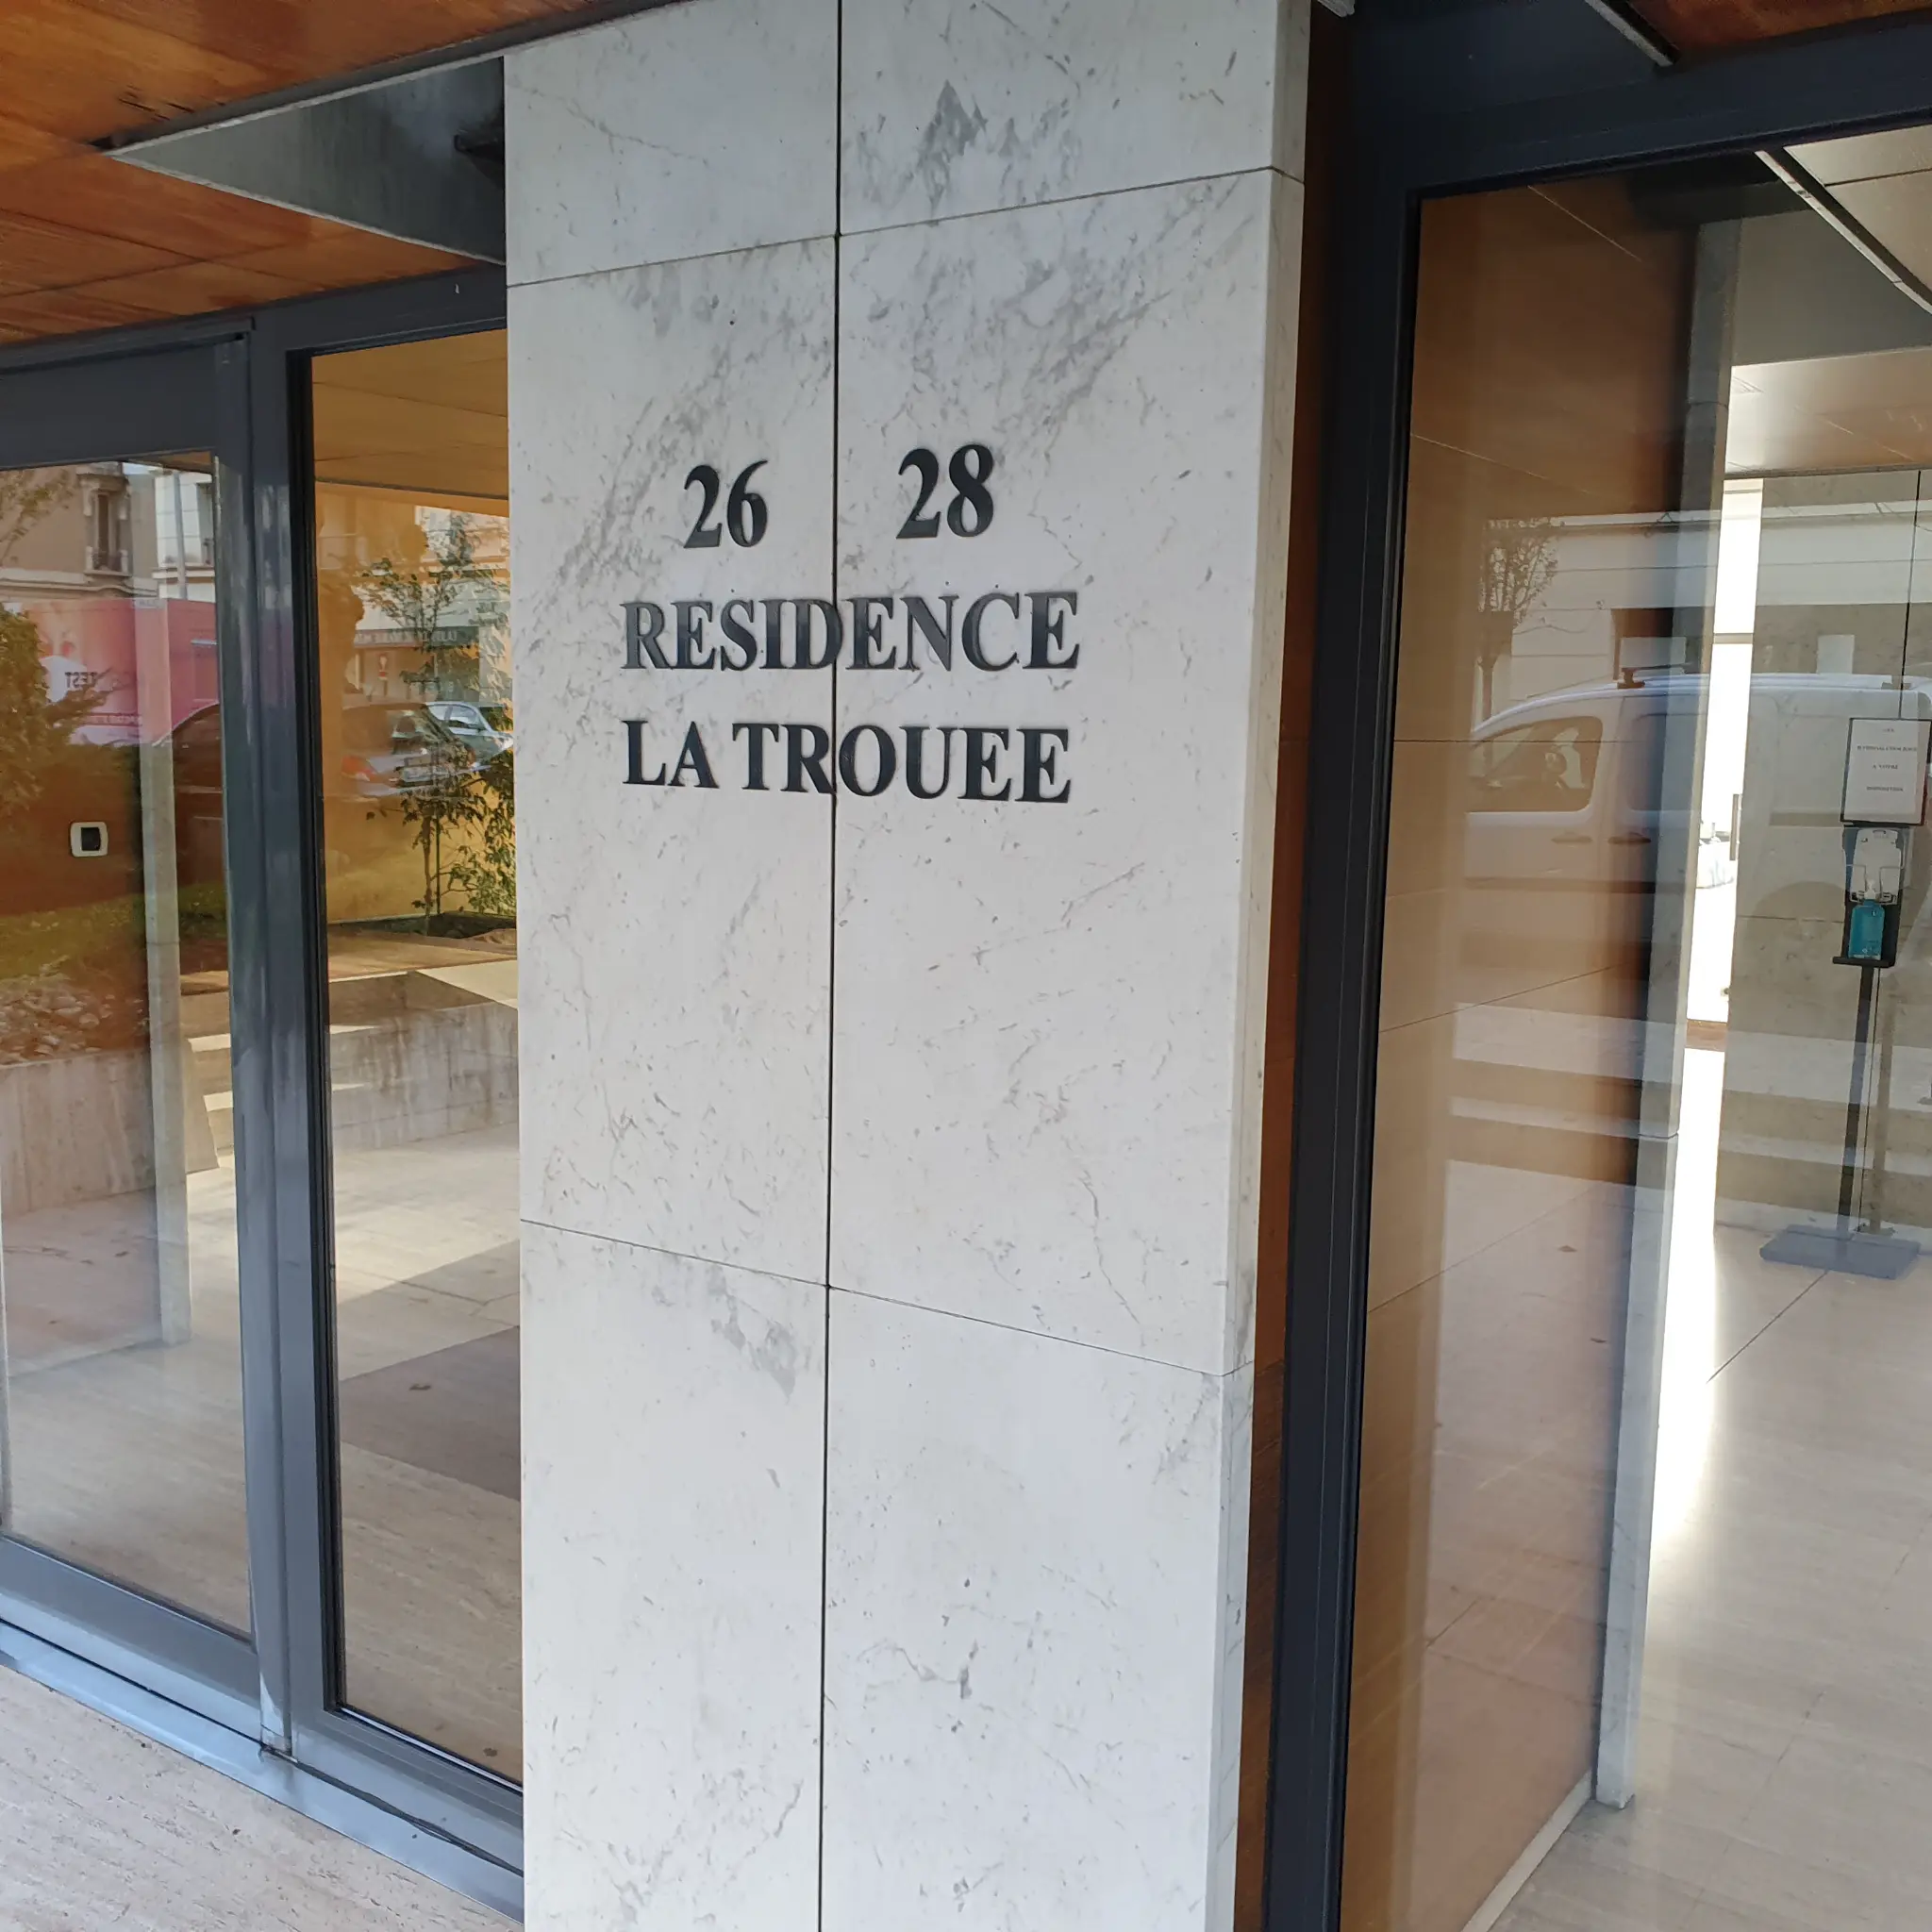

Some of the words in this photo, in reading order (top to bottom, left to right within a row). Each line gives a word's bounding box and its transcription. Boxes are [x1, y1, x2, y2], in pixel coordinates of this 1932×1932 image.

[683, 459, 769, 549] 26
[895, 443, 995, 540] 28
[619, 591, 1081, 672] RESIDENCE
[622, 720, 720, 790] LA
[732, 723, 1072, 804] TROUEE
